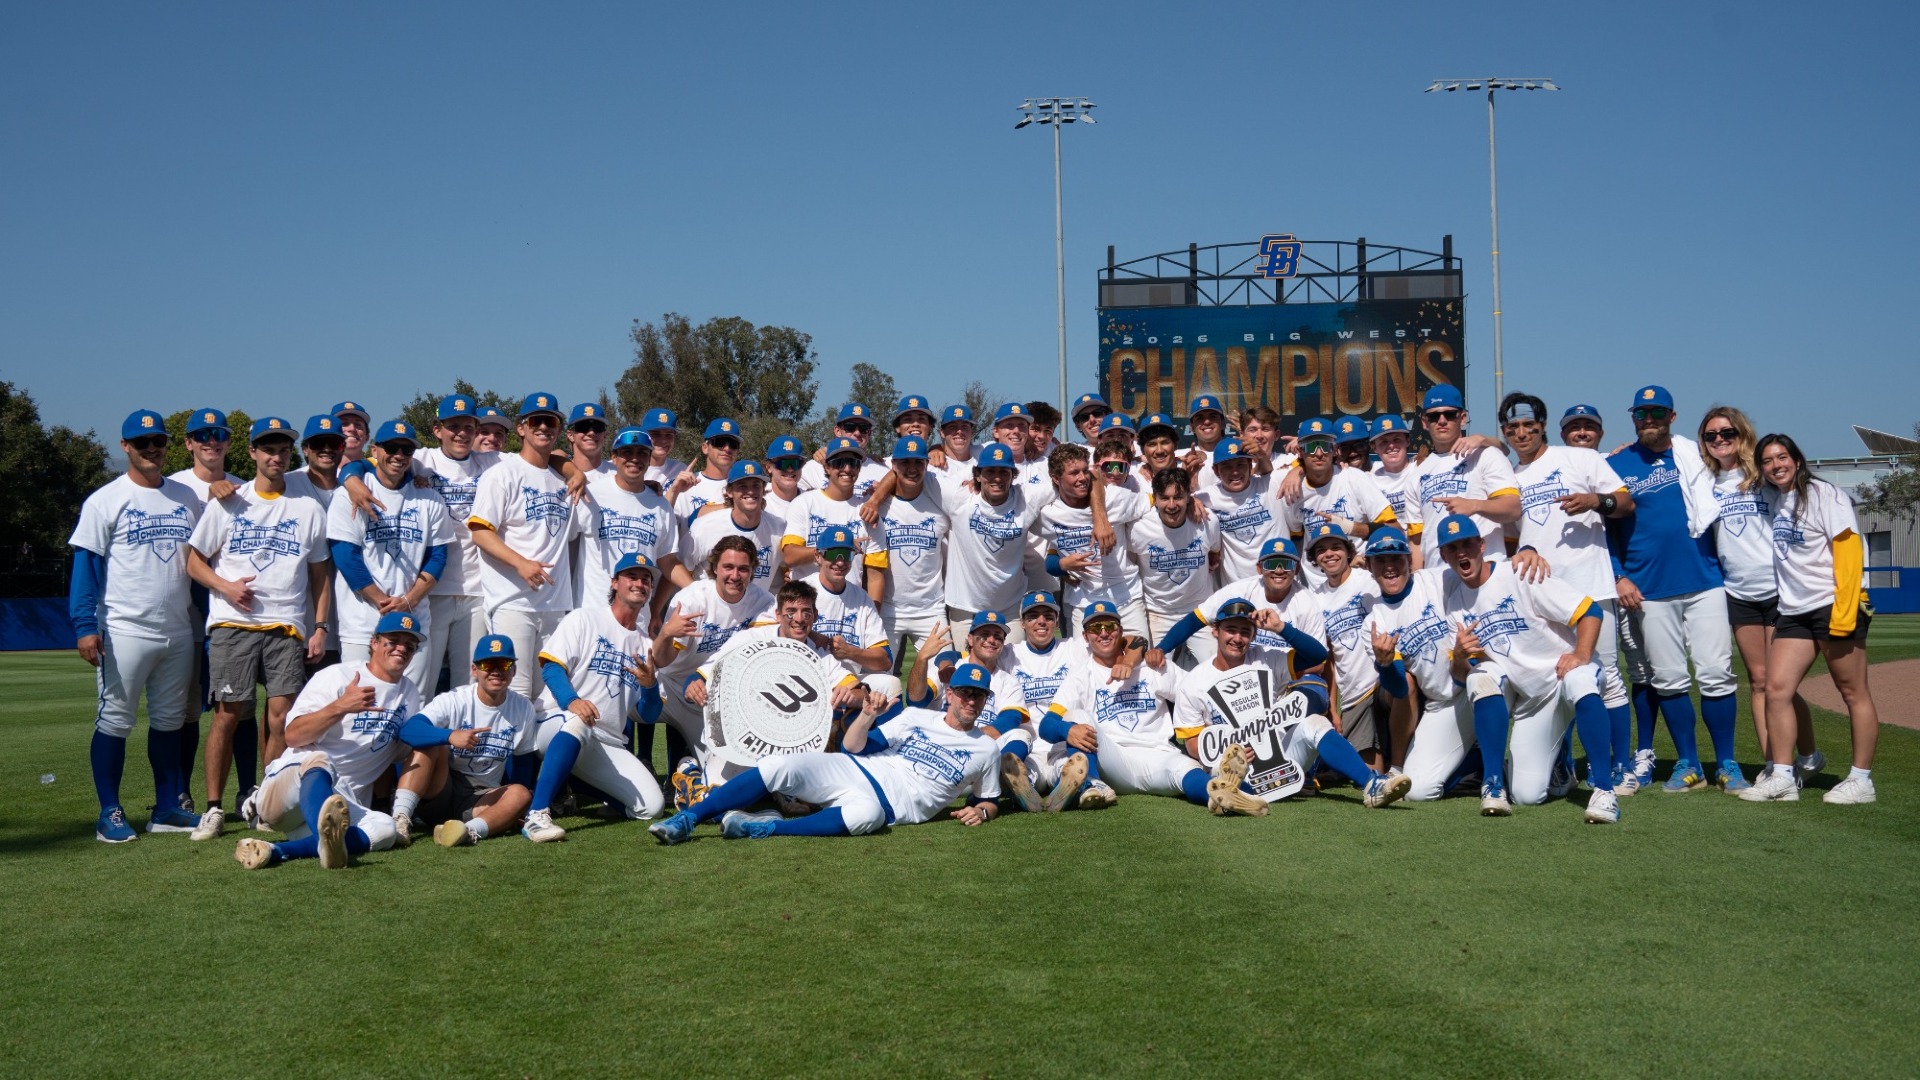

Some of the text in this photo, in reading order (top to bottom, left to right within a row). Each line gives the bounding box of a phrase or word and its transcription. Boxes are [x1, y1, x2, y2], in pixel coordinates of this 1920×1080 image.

[1254, 233, 1302, 279] SB
[1122, 334, 1208, 344] 2026
[1337, 328, 1432, 338] WEST
[1109, 341, 1455, 420] CHAMPIONS
[1623, 476, 1659, 494] Santa
[1225, 516, 1260, 528] CHAMPIONS
[140, 528, 184, 539] CHAMPIONS
[610, 528, 648, 540] CHAMPIONS
[978, 524, 1012, 537] CHAMPIONS
[242, 539, 286, 550] CHAMPIONS
[1159, 560, 1197, 569] CHAMPIONS
[1230, 693, 1260, 707] REGULAR
[1108, 702, 1144, 715] CHAMPIONS
[1235, 701, 1260, 713] SEASON
[1203, 696, 1304, 761] Champions
[908, 749, 953, 775] CHAMPIONS
